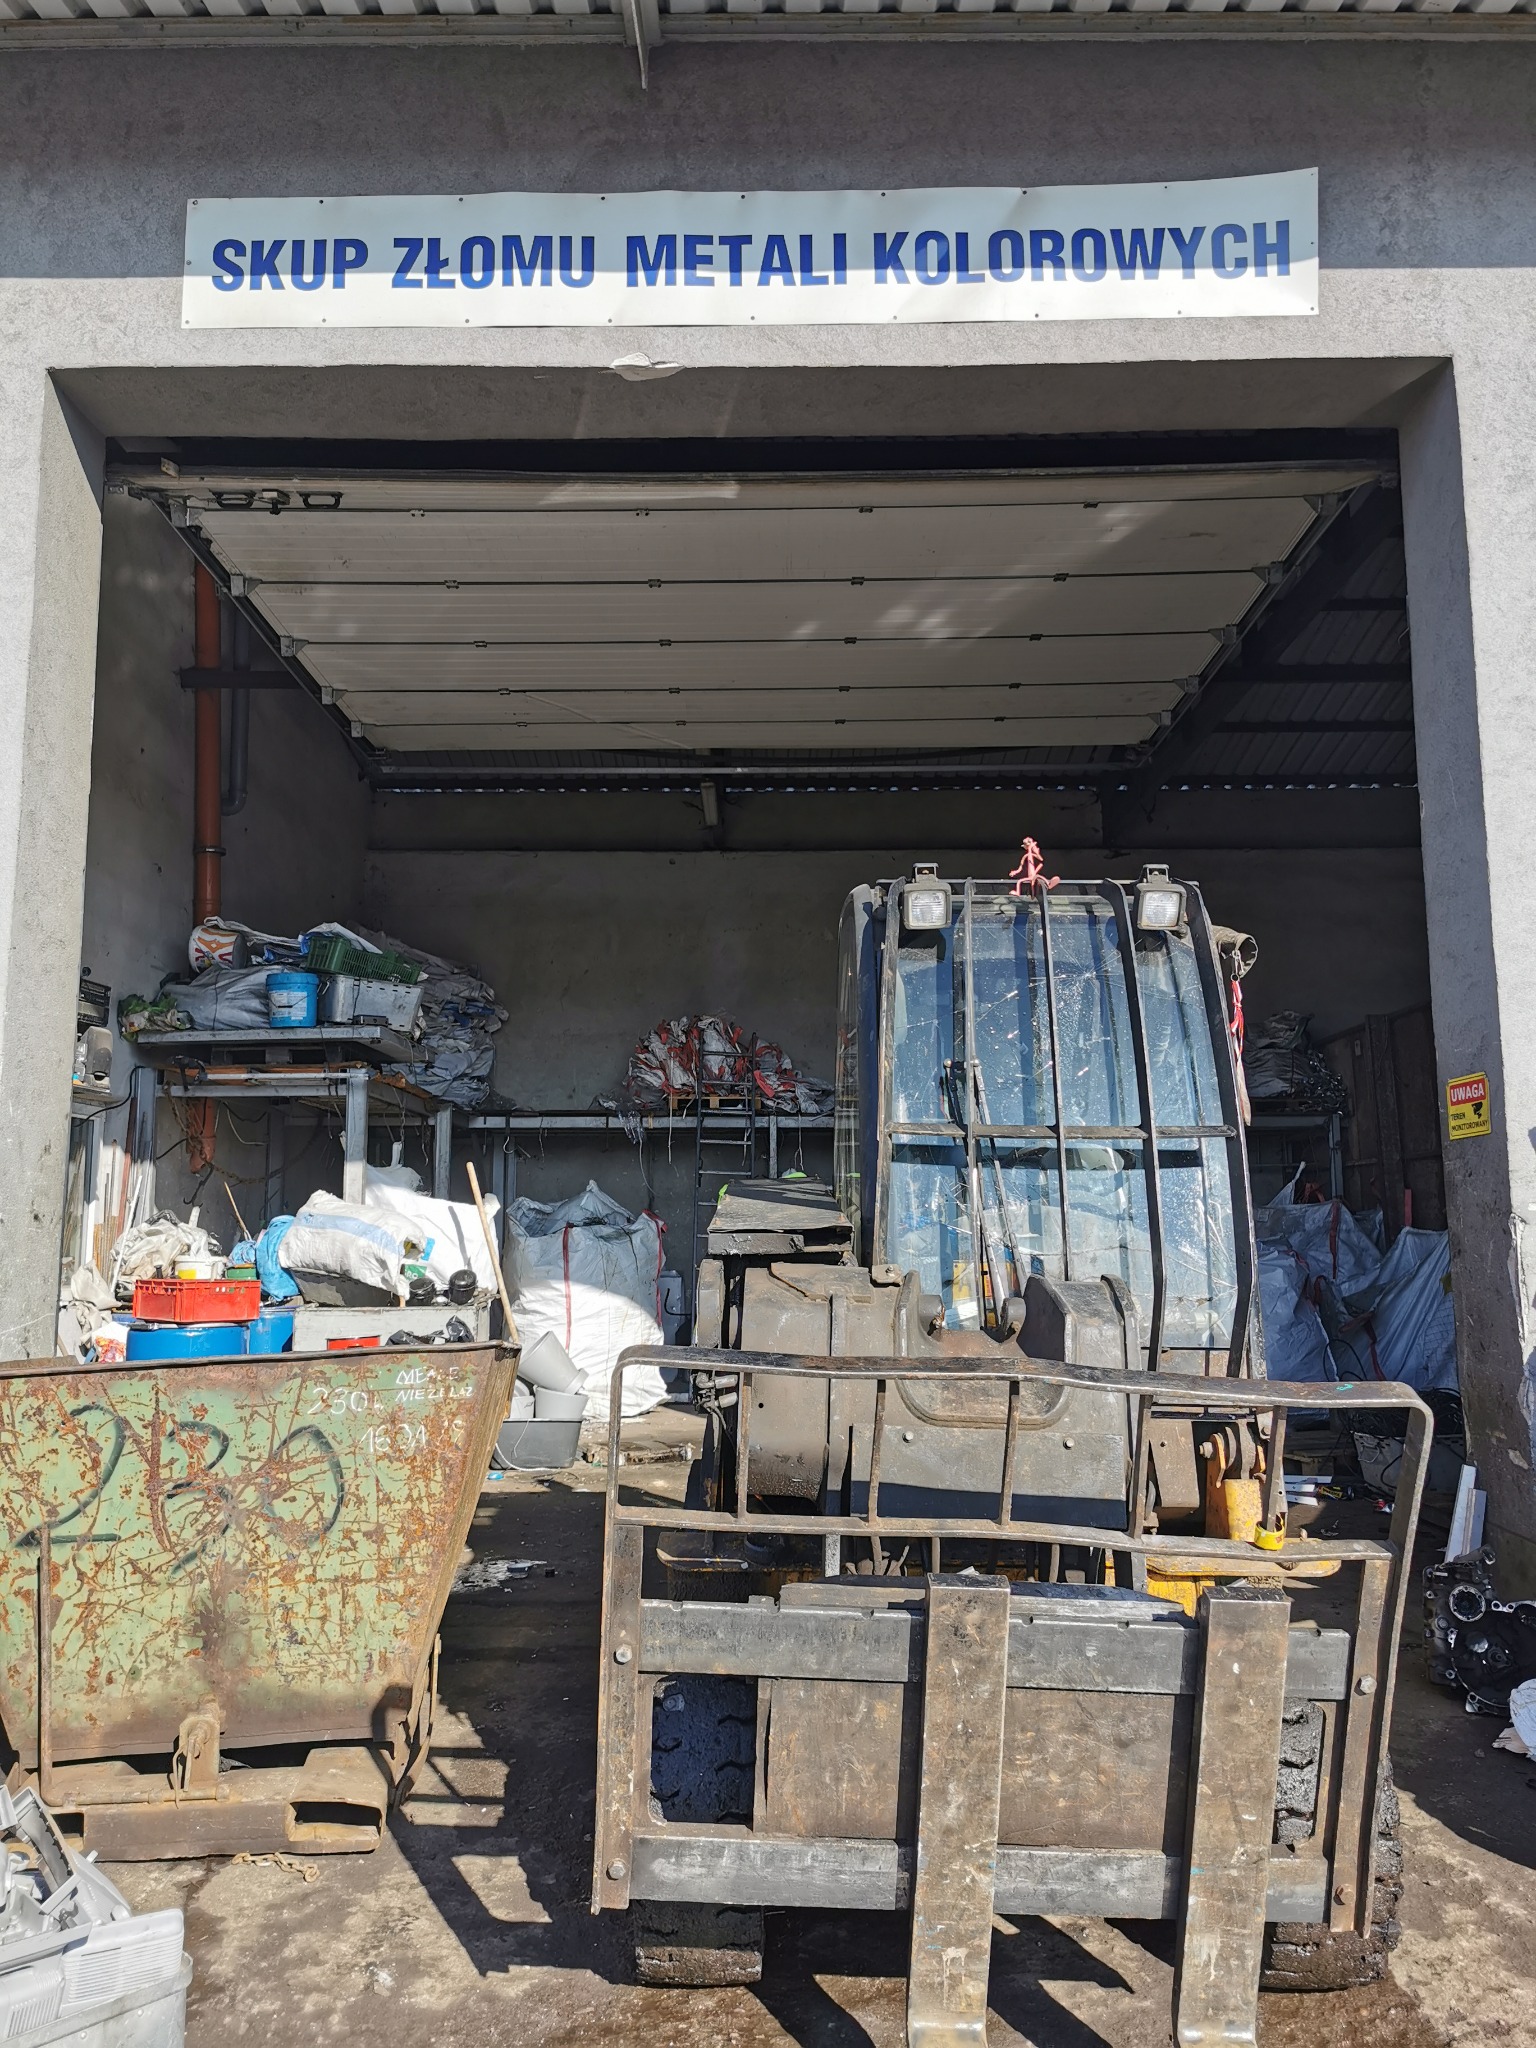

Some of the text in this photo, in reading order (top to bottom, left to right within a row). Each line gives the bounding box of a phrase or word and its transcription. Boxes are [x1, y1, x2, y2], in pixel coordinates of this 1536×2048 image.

[212, 221, 1290, 292] SKUP ZŁOMU METALI KOLOROWYCH
[1451, 1083, 1484, 1102] UWAGA
